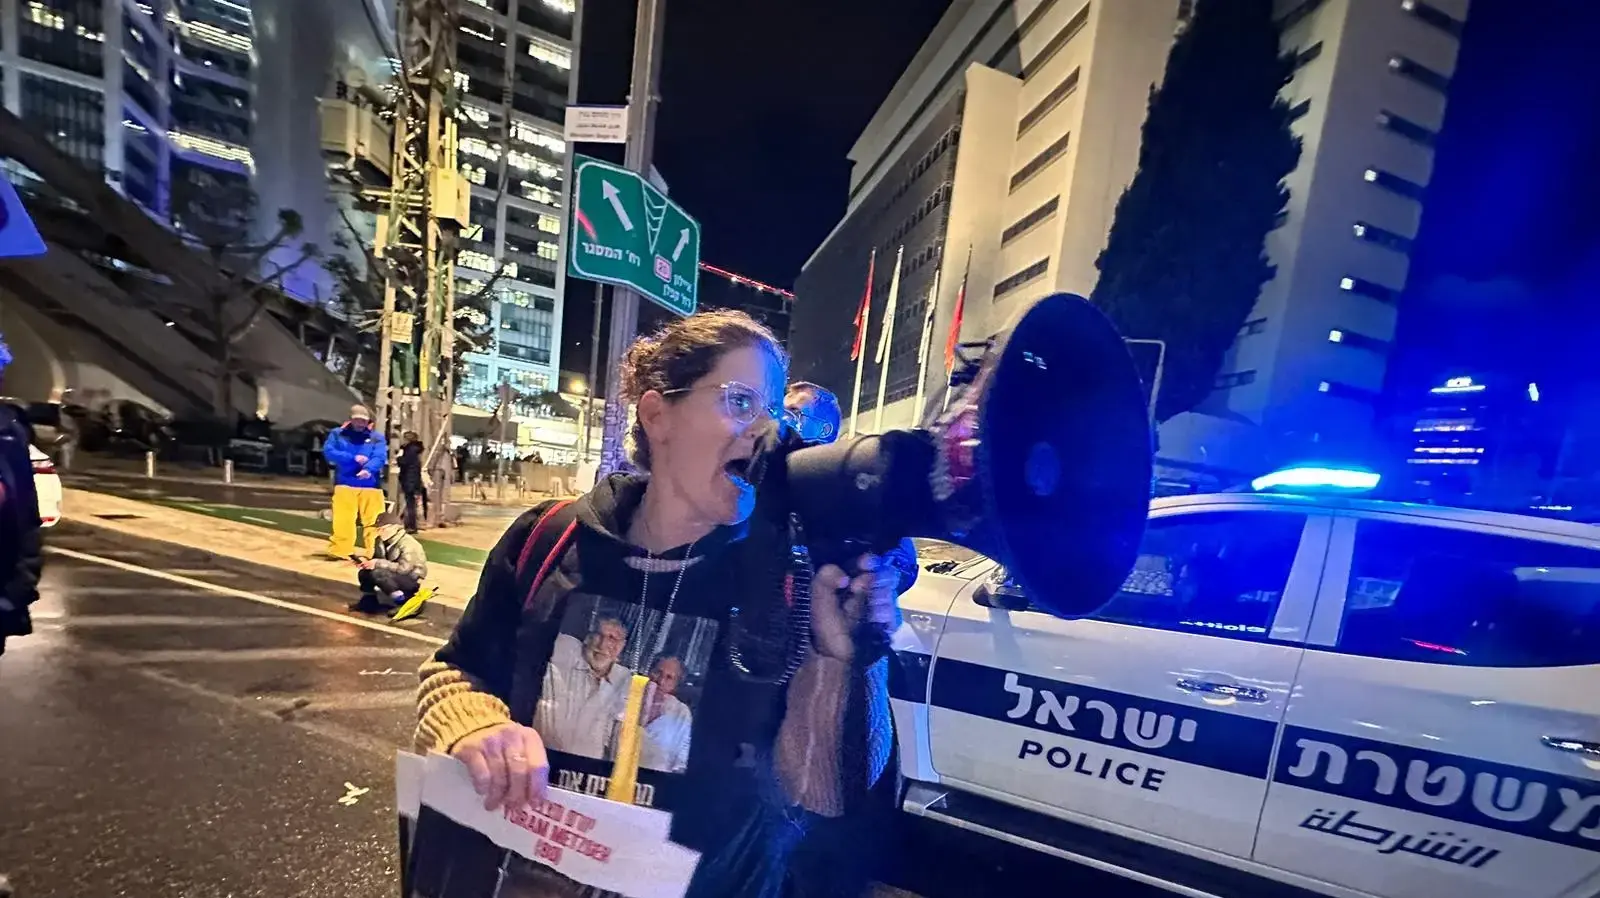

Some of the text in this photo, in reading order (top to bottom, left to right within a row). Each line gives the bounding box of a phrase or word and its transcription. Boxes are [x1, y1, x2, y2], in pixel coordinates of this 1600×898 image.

[581, 242, 623, 260] המסגר
[1003, 673, 1600, 840] משטרת ישראל
[1018, 739, 1166, 792] POLICE
[1298, 807, 1501, 868] الشرطة
